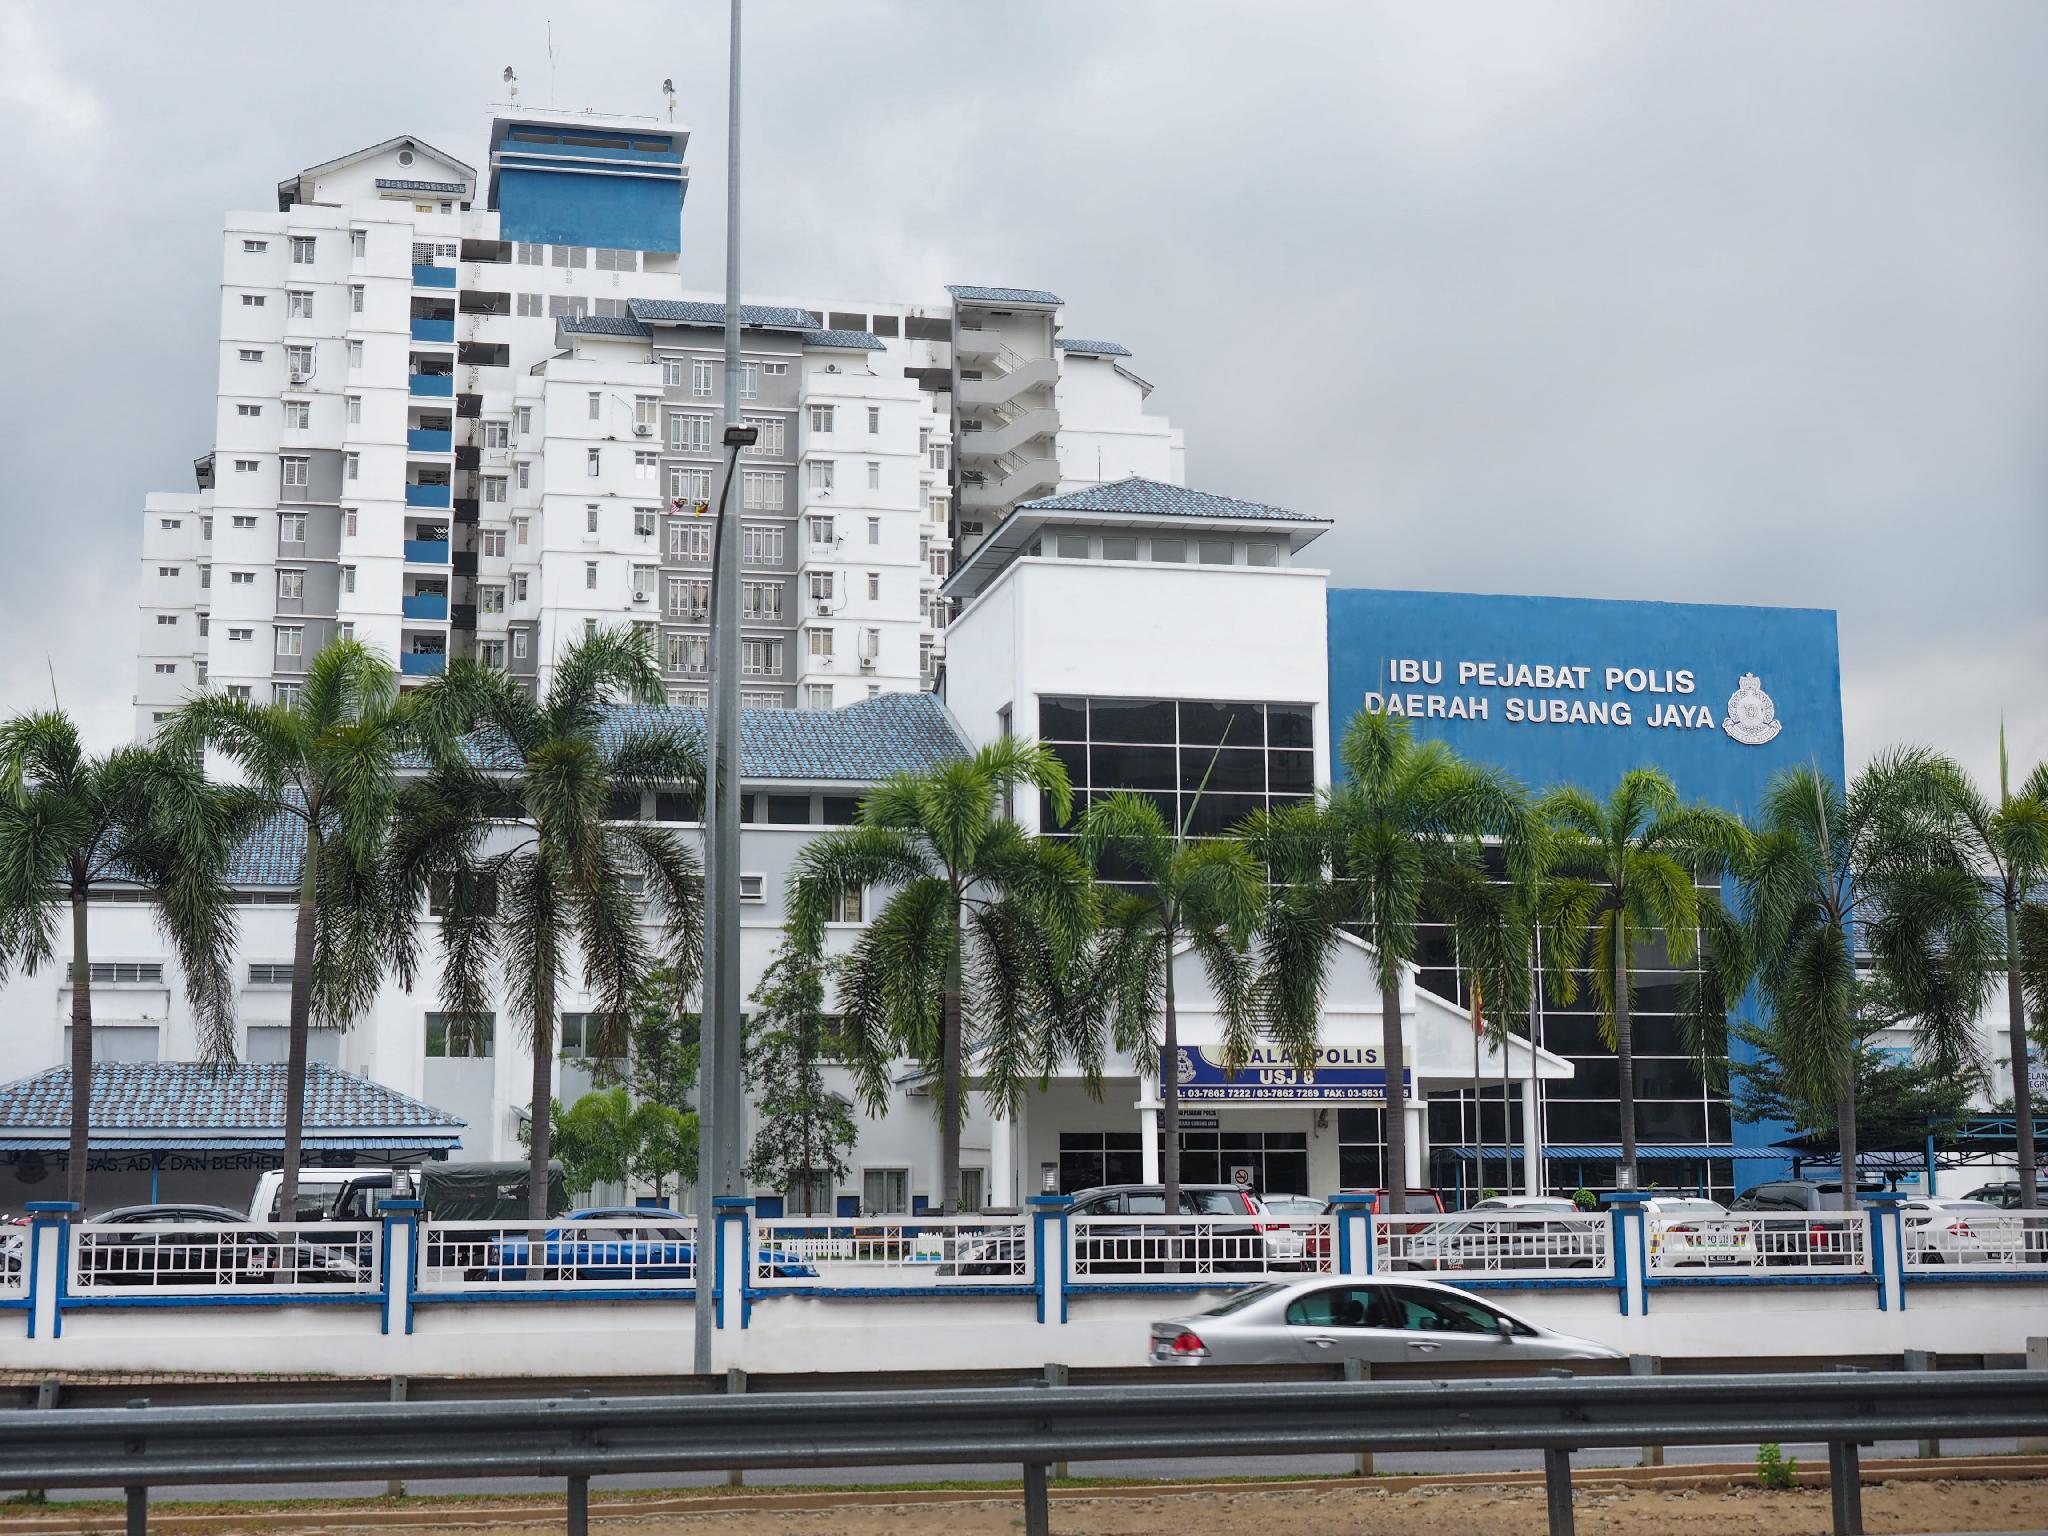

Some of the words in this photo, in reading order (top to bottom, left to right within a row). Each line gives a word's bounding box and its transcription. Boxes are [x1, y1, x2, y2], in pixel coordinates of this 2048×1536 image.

[1390, 659, 1442, 684] IBU
[1459, 661, 1591, 690] PEJABAT
[1605, 667, 1696, 694] POLIS
[1364, 691, 1488, 721] DAERAH
[1505, 697, 1632, 726] SUBANG
[1647, 703, 1715, 729] JAYA
[1313, 1048, 1377, 1064] POLIS
[1259, 1069, 1297, 1085] USJ
[1187, 1089, 1225, 1098] 03-7862
[1227, 1089, 1251, 1098] 7222
[1256, 1089, 1294, 1098] 03-7862
[1323, 1089, 1346, 1098] FAX:
[171, 1156, 206, 1171] DAN
